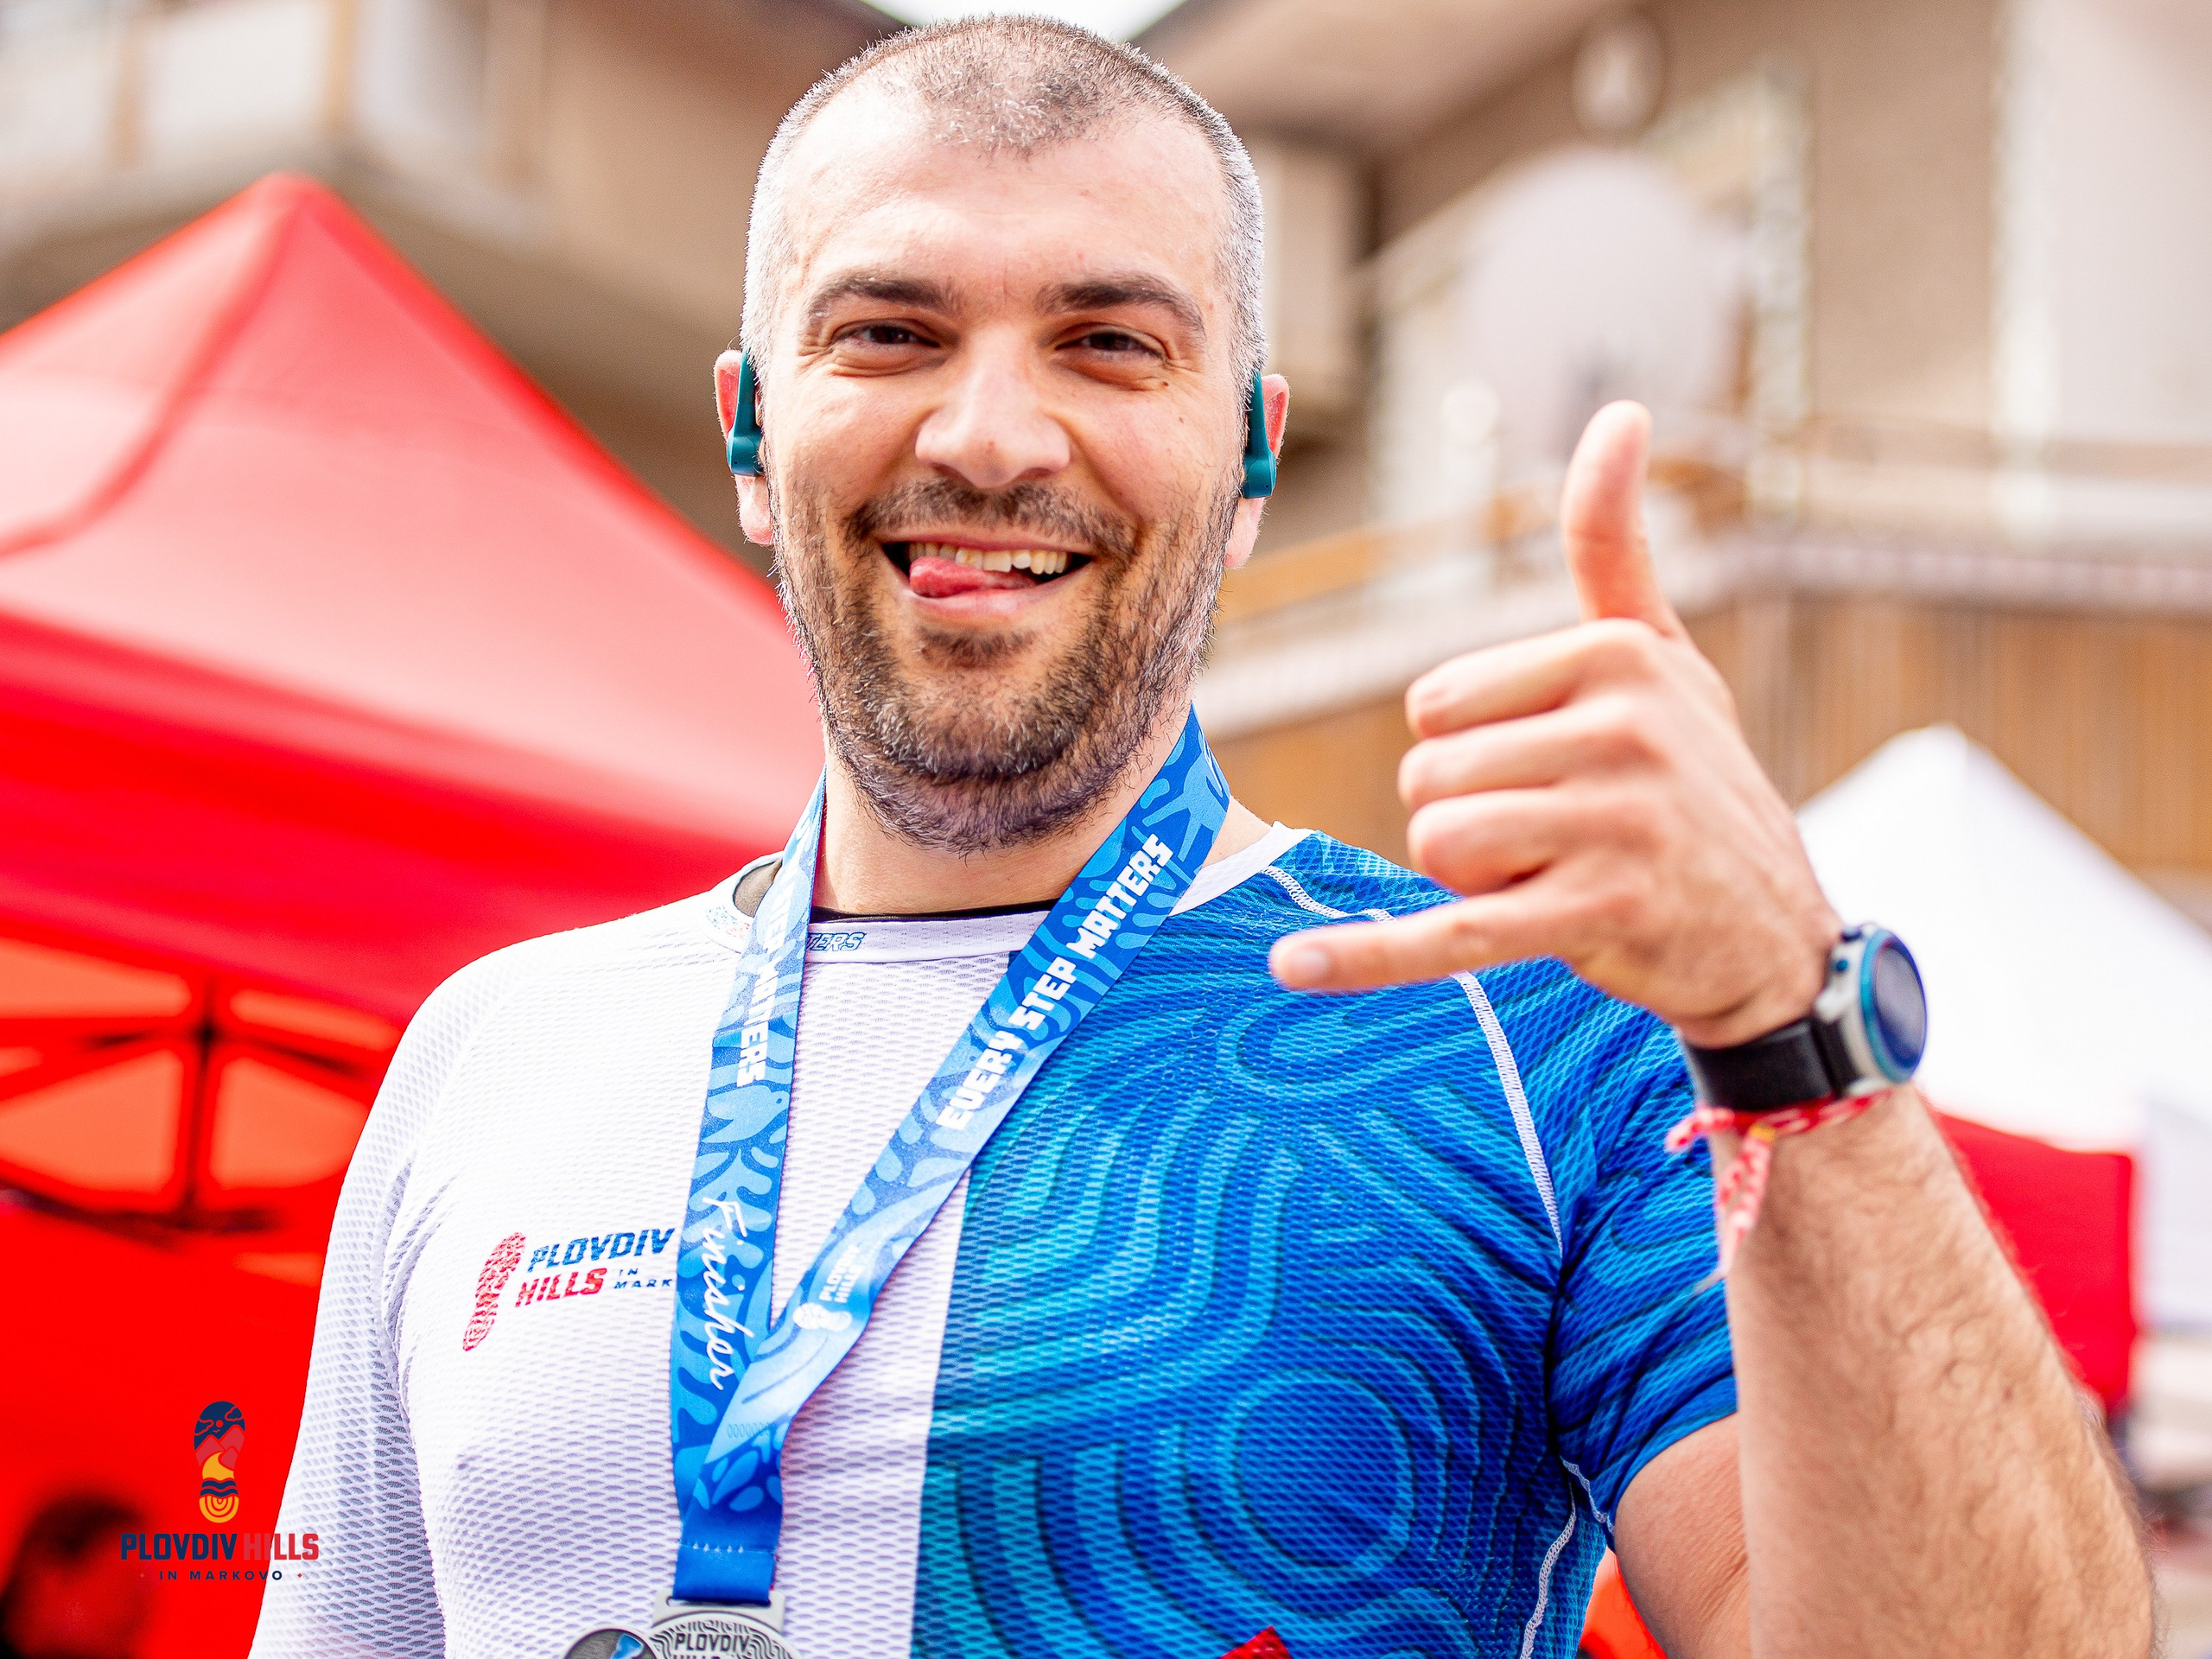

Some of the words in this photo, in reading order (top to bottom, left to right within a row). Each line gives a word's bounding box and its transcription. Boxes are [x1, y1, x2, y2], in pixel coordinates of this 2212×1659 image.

[806, 931, 867, 951] TERS
[1007, 956, 1077, 1031] STEP
[1066, 833, 1173, 959] MATTERS
[736, 953, 780, 1087] MATTERS
[527, 1228, 676, 1273] PLOVDIV
[515, 1268, 608, 1307] HILLS
[613, 1279, 673, 1289] MARK
[701, 1195, 756, 1391] Finisher
[675, 1633, 750, 1652] PLOVDIV
